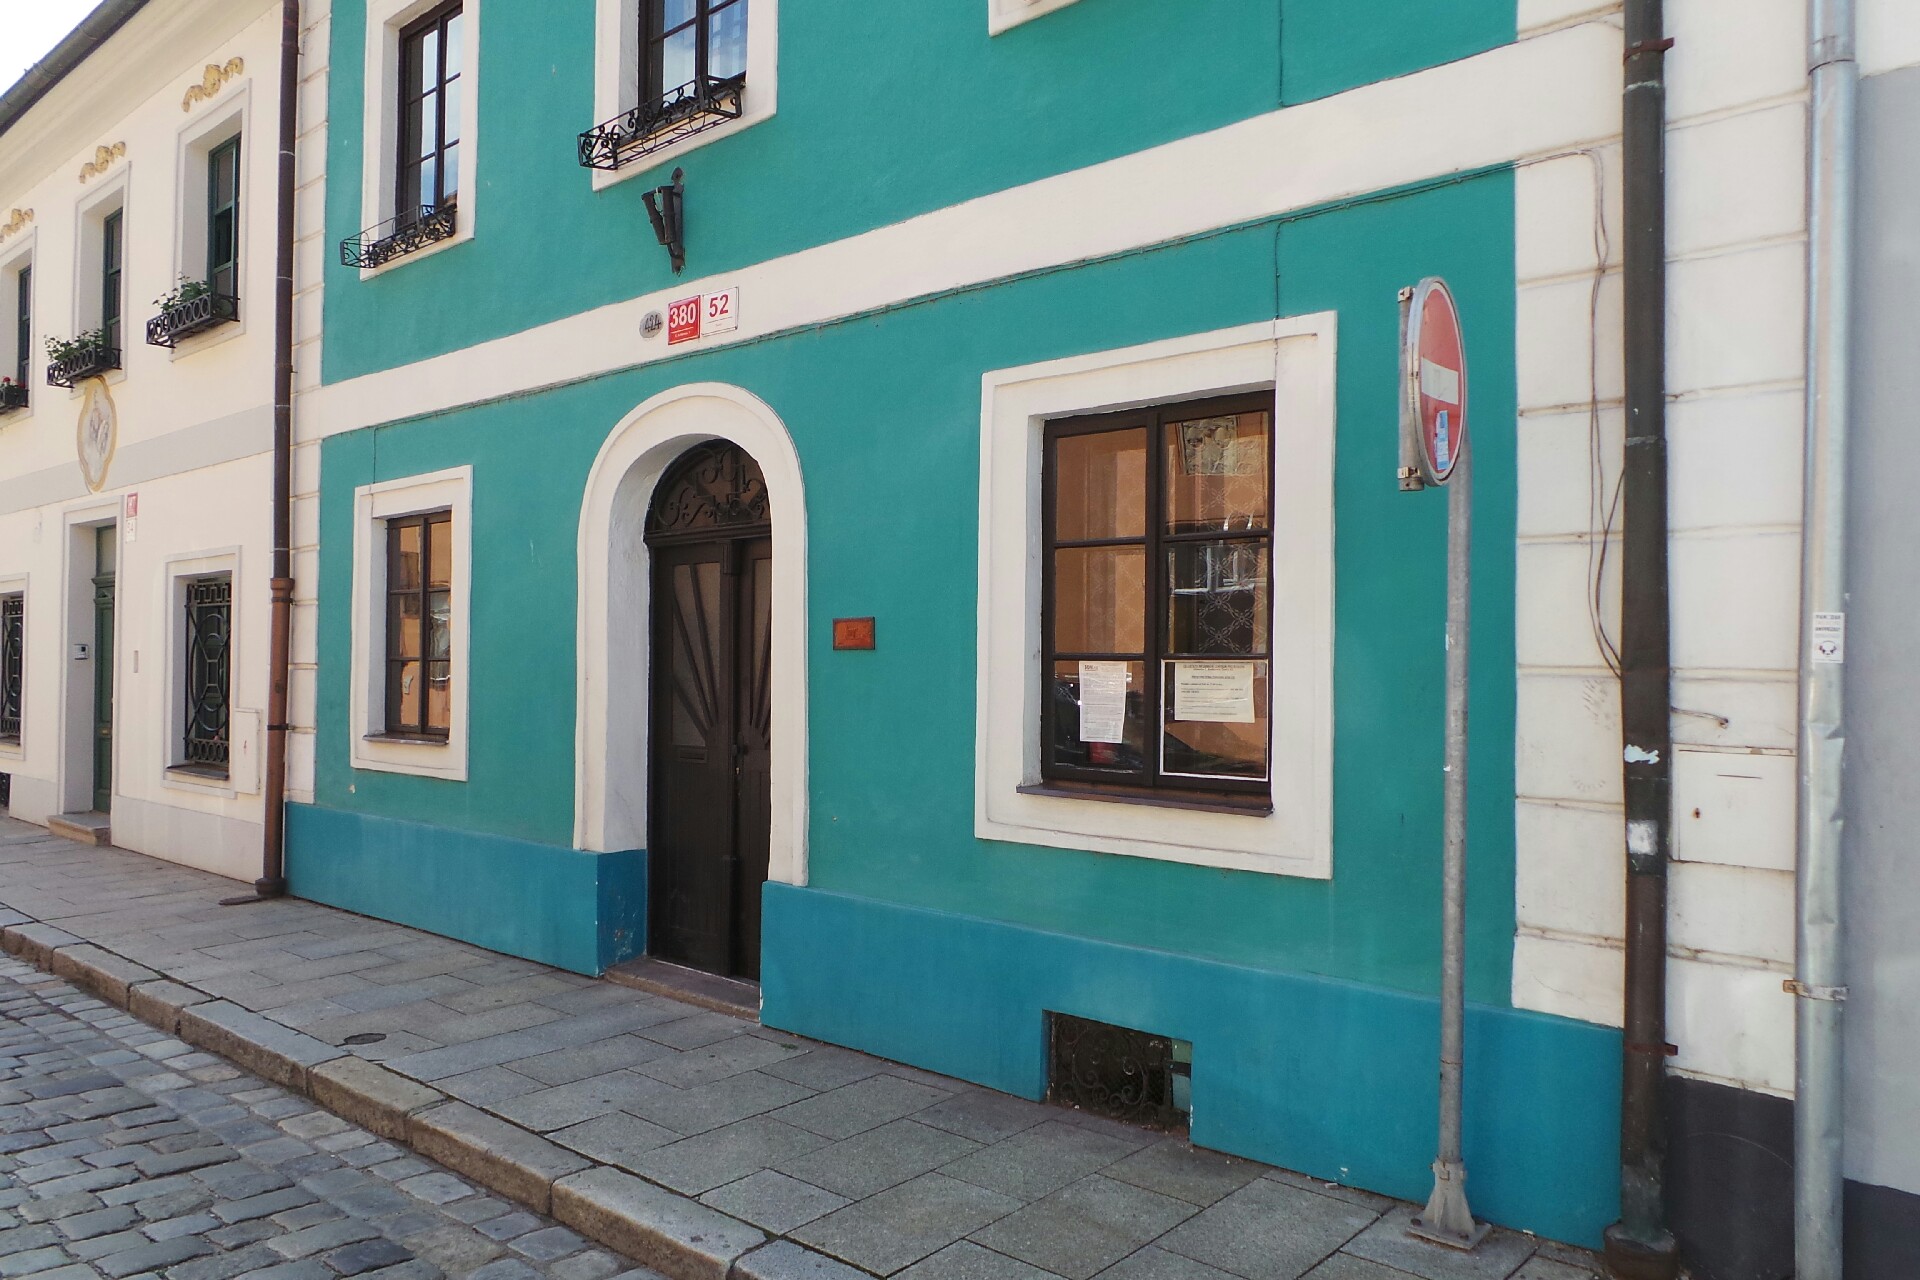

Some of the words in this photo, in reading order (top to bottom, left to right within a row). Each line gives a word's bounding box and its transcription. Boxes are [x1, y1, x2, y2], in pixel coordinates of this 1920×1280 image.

[670, 303, 697, 328] 380
[709, 294, 729, 317] 52
[645, 315, 662, 332] 424
